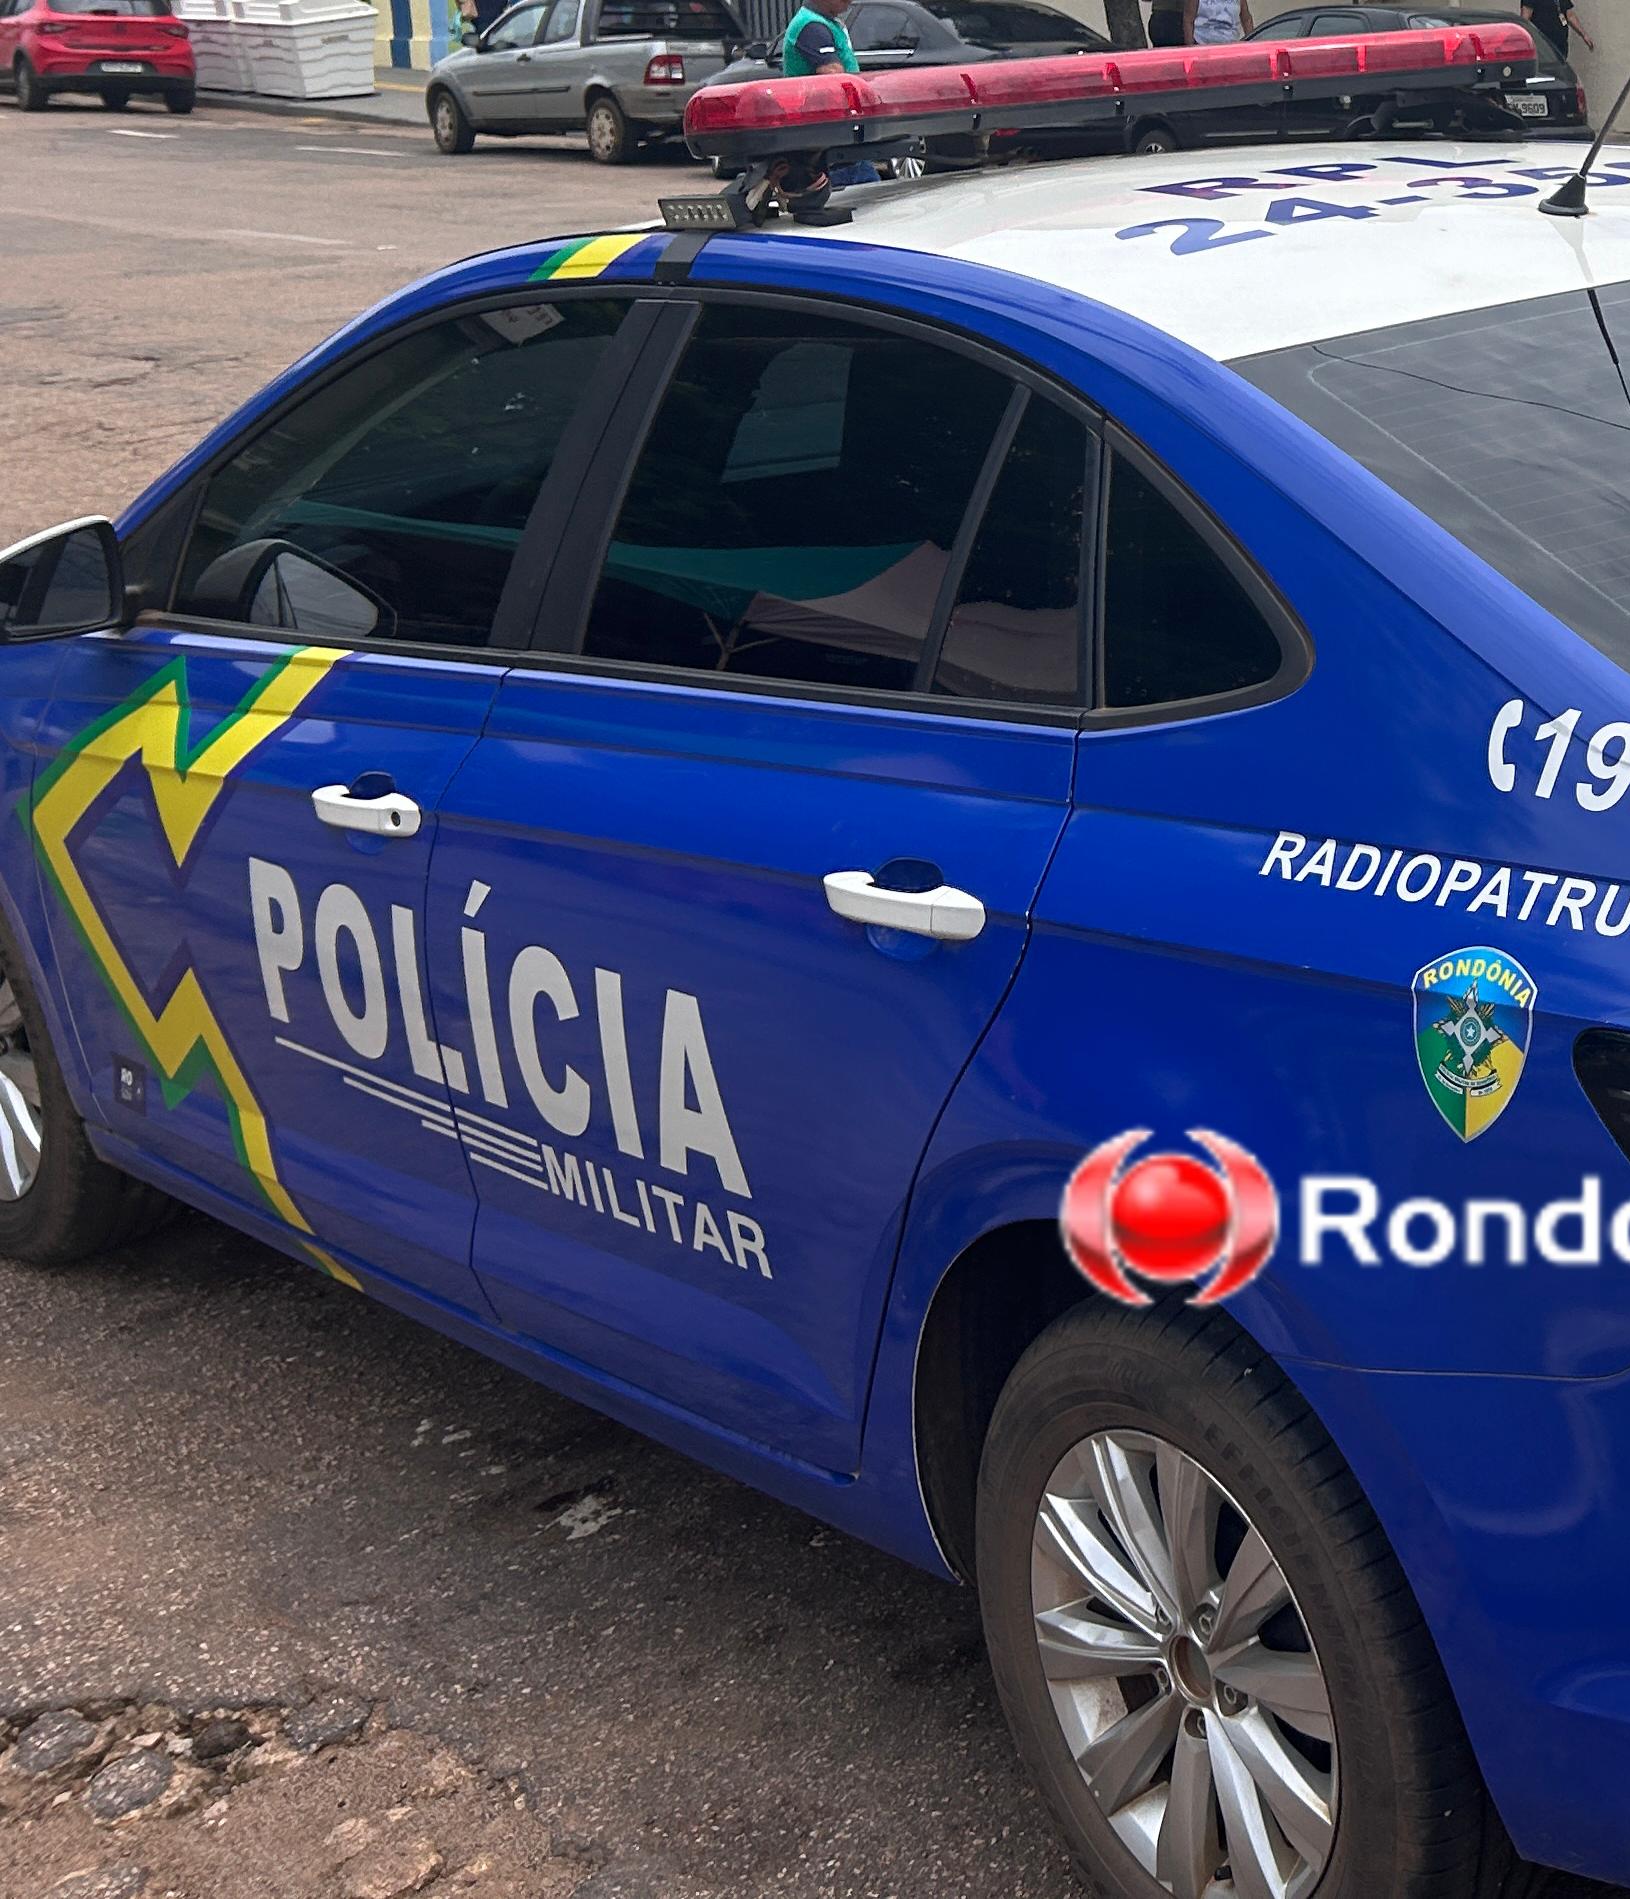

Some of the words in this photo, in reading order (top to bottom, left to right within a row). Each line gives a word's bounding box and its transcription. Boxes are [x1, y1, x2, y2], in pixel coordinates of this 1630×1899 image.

[1136, 156, 1520, 199] RPL
[248, 856, 752, 1199] POLÍCIA
[1422, 959, 1531, 1008] RONDÔNIA
[541, 1143, 773, 1280] MILITAR
